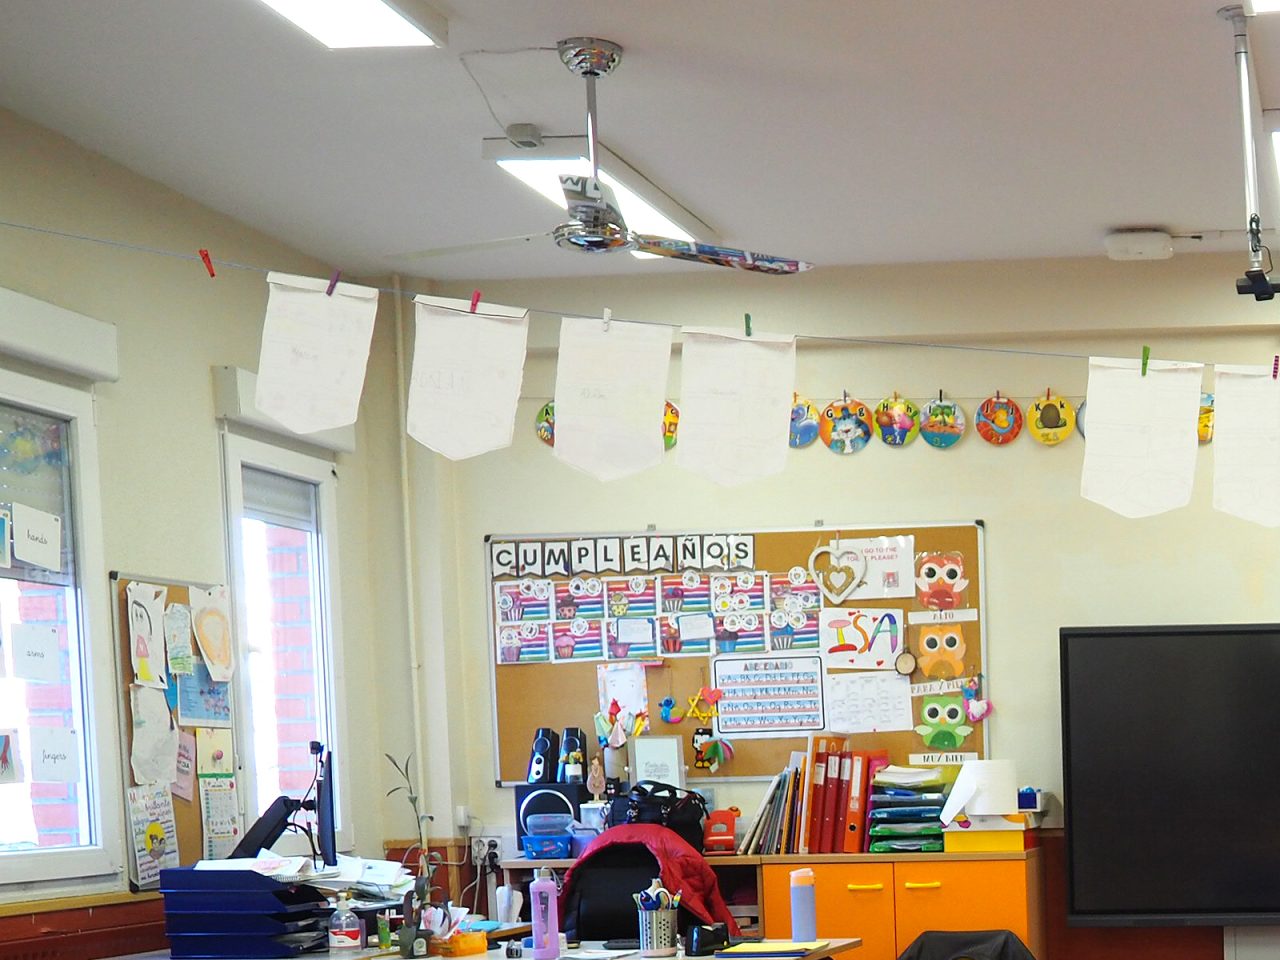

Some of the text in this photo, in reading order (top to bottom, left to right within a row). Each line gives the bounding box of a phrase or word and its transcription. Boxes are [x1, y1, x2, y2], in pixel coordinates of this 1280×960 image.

[882, 403, 912, 412] H h
[1035, 401, 1065, 412] K k
[826, 408, 865, 418] G g
[496, 538, 749, 567] CUMPLEAÑOS
[828, 613, 898, 654] ISA
